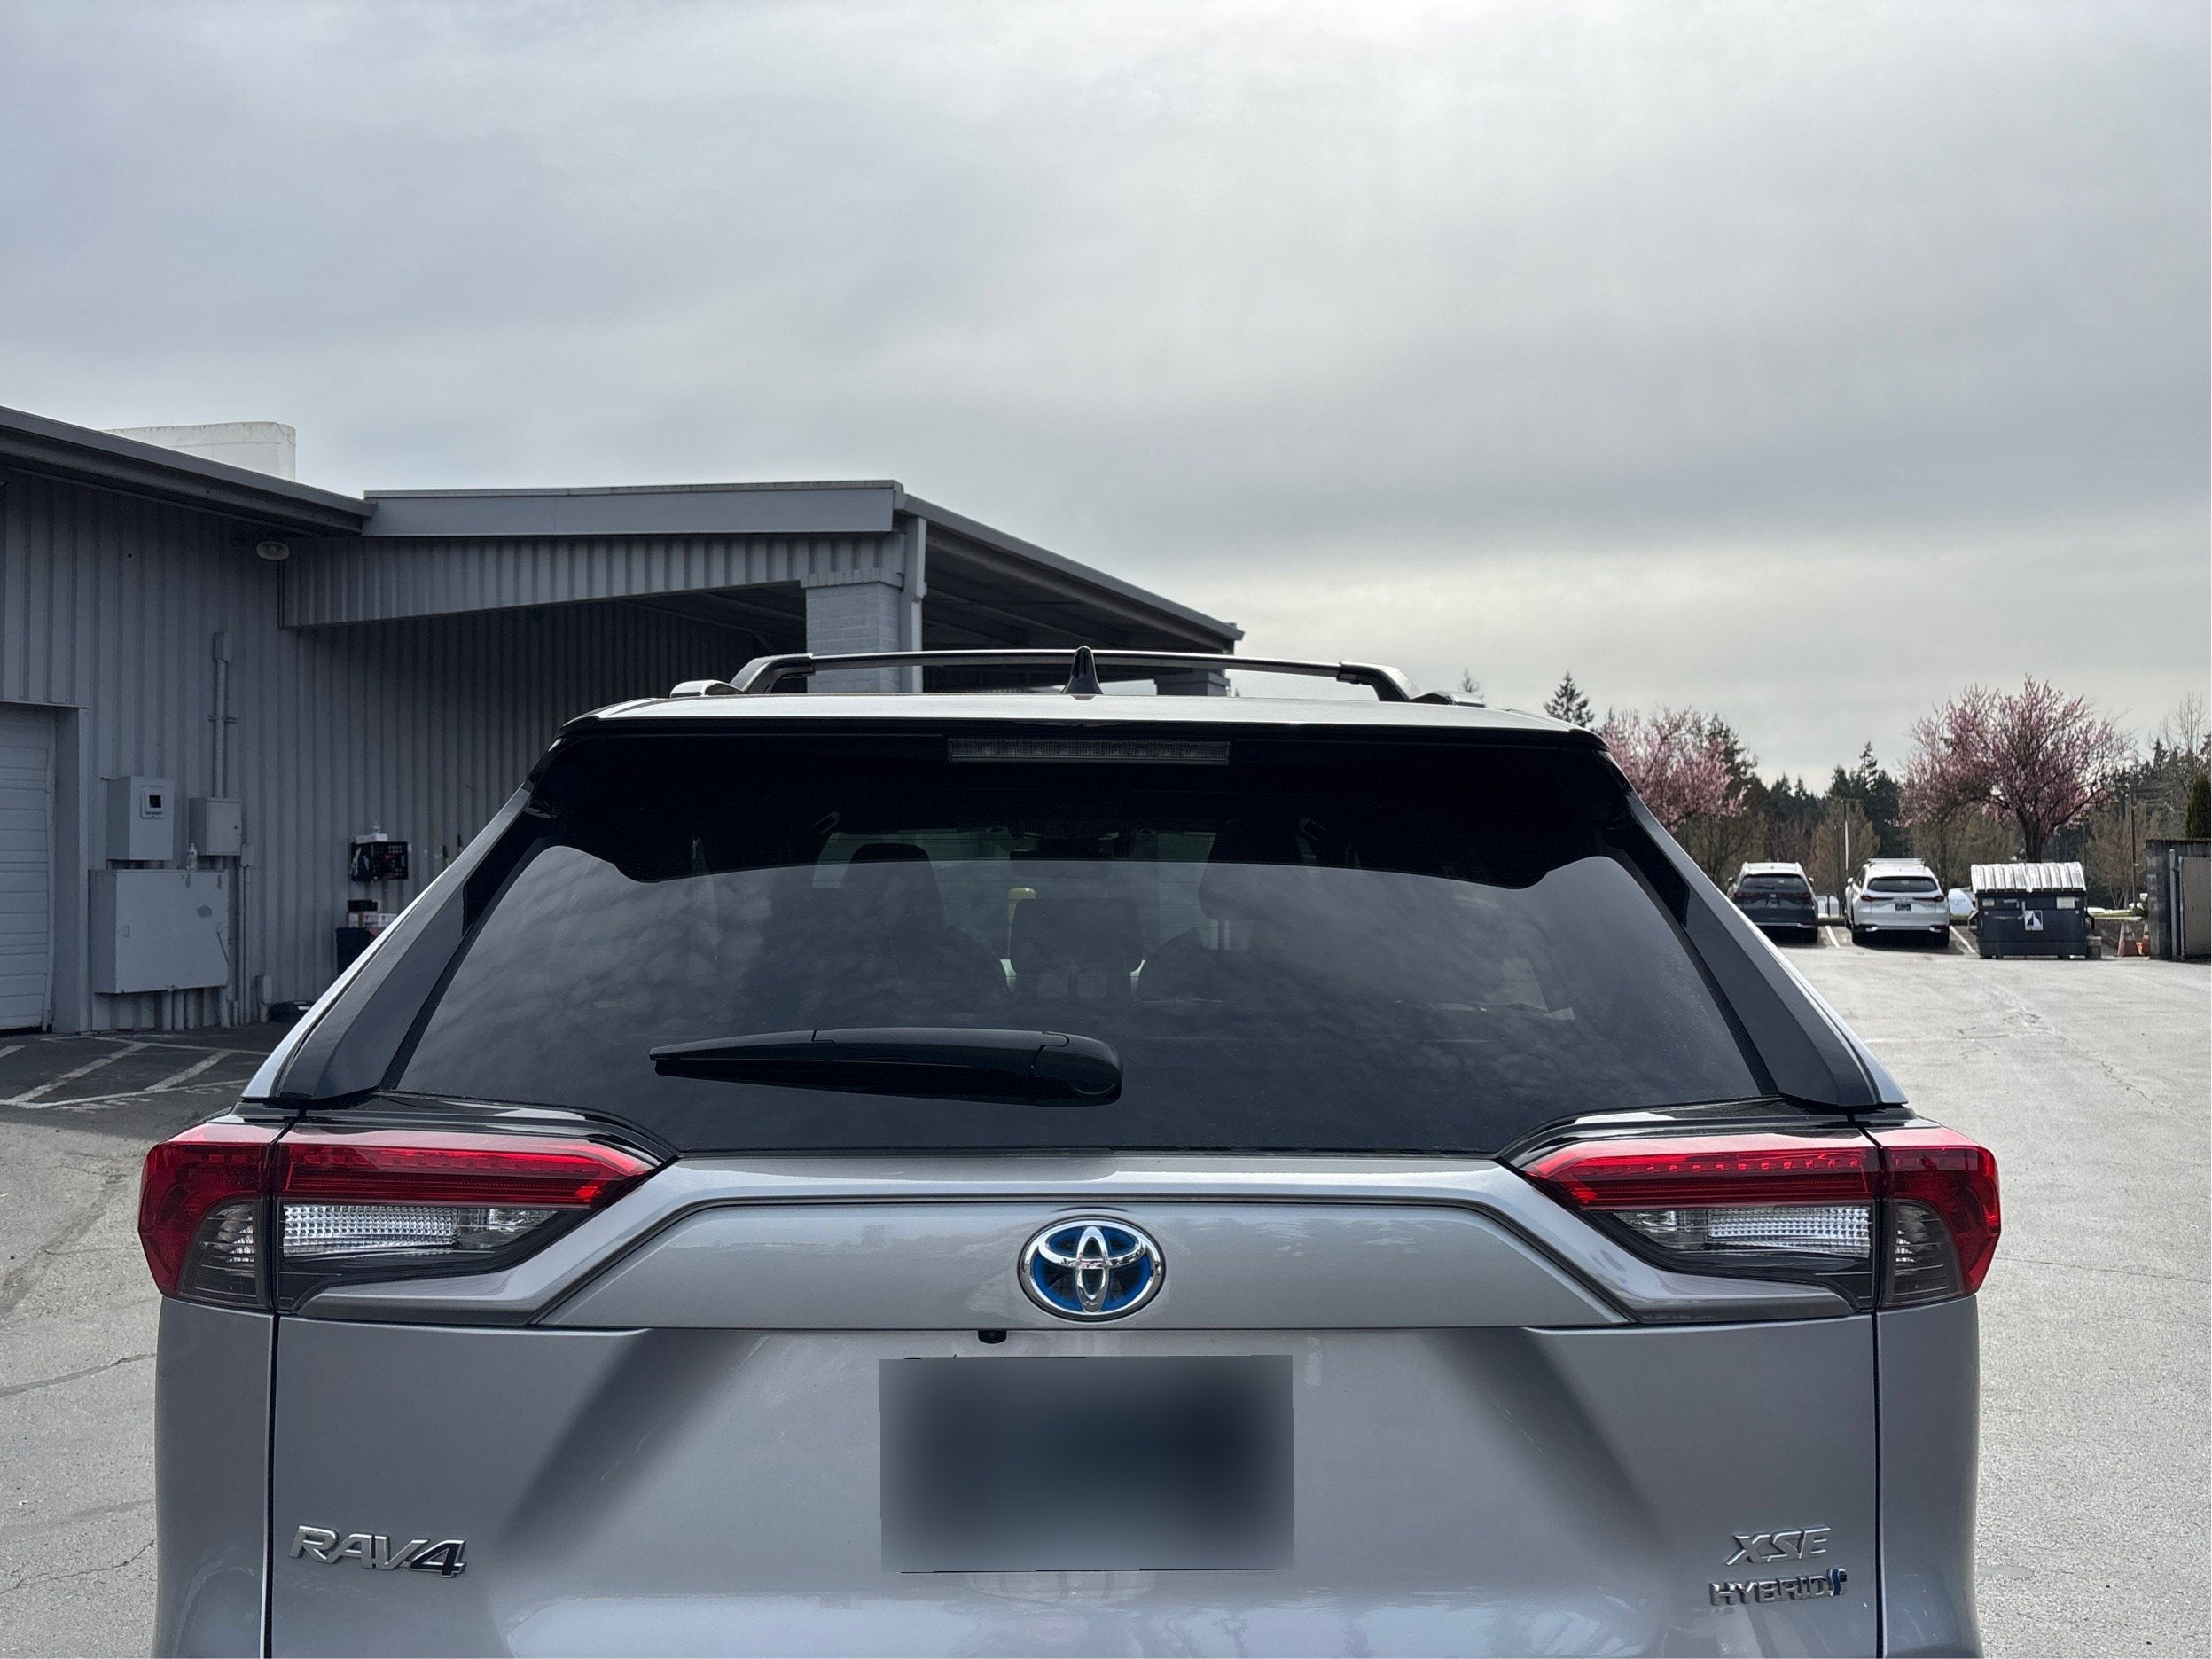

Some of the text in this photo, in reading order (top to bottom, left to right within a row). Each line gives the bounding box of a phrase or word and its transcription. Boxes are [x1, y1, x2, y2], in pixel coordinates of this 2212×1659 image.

[289, 1525, 466, 1577] RAV4
[1724, 1526, 1831, 1565] XSE
[1709, 1575, 1830, 1606] HYBRID
